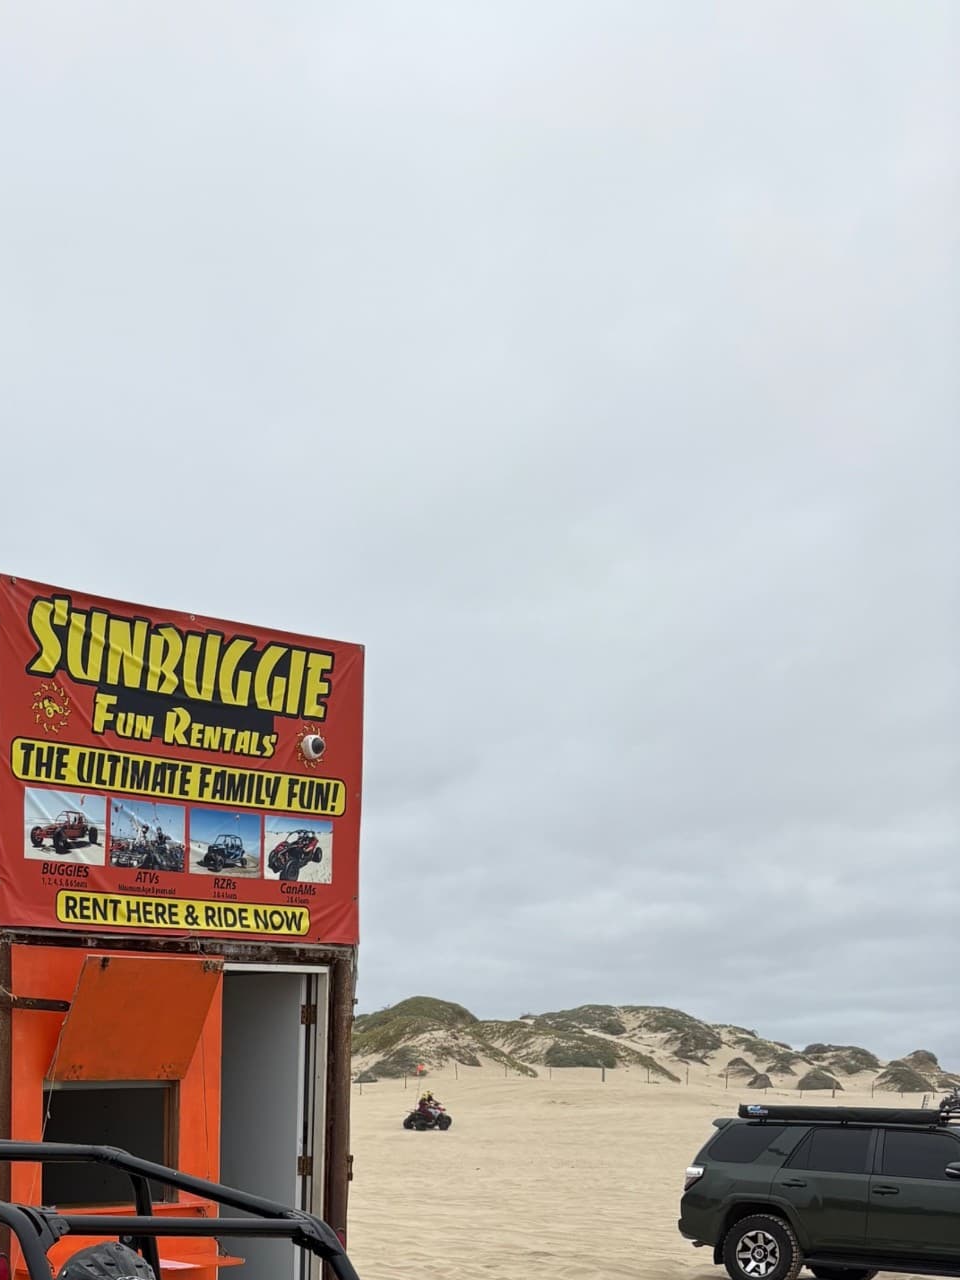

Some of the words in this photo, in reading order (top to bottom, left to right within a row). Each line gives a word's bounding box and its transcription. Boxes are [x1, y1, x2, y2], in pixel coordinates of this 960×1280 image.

[30, 599, 333, 719] SUNBUGGIE
[93, 692, 154, 740] FUN
[164, 707, 277, 758] RENTALS
[20, 743, 68, 781] THE
[77, 751, 191, 796] ULTIMATE
[198, 769, 282, 807] FAMILY
[287, 778, 340, 813] FUN!
[41, 862, 90, 878] BUGGIES
[135, 871, 160, 885] ATVs
[213, 878, 237, 890] RZRs
[280, 882, 317, 896] CanAMs
[65, 895, 121, 922] RENT
[125, 900, 180, 926] HERE
[184, 904, 201, 927] &
[204, 905, 251, 929] RIDE
[253, 908, 304, 932] NOW
